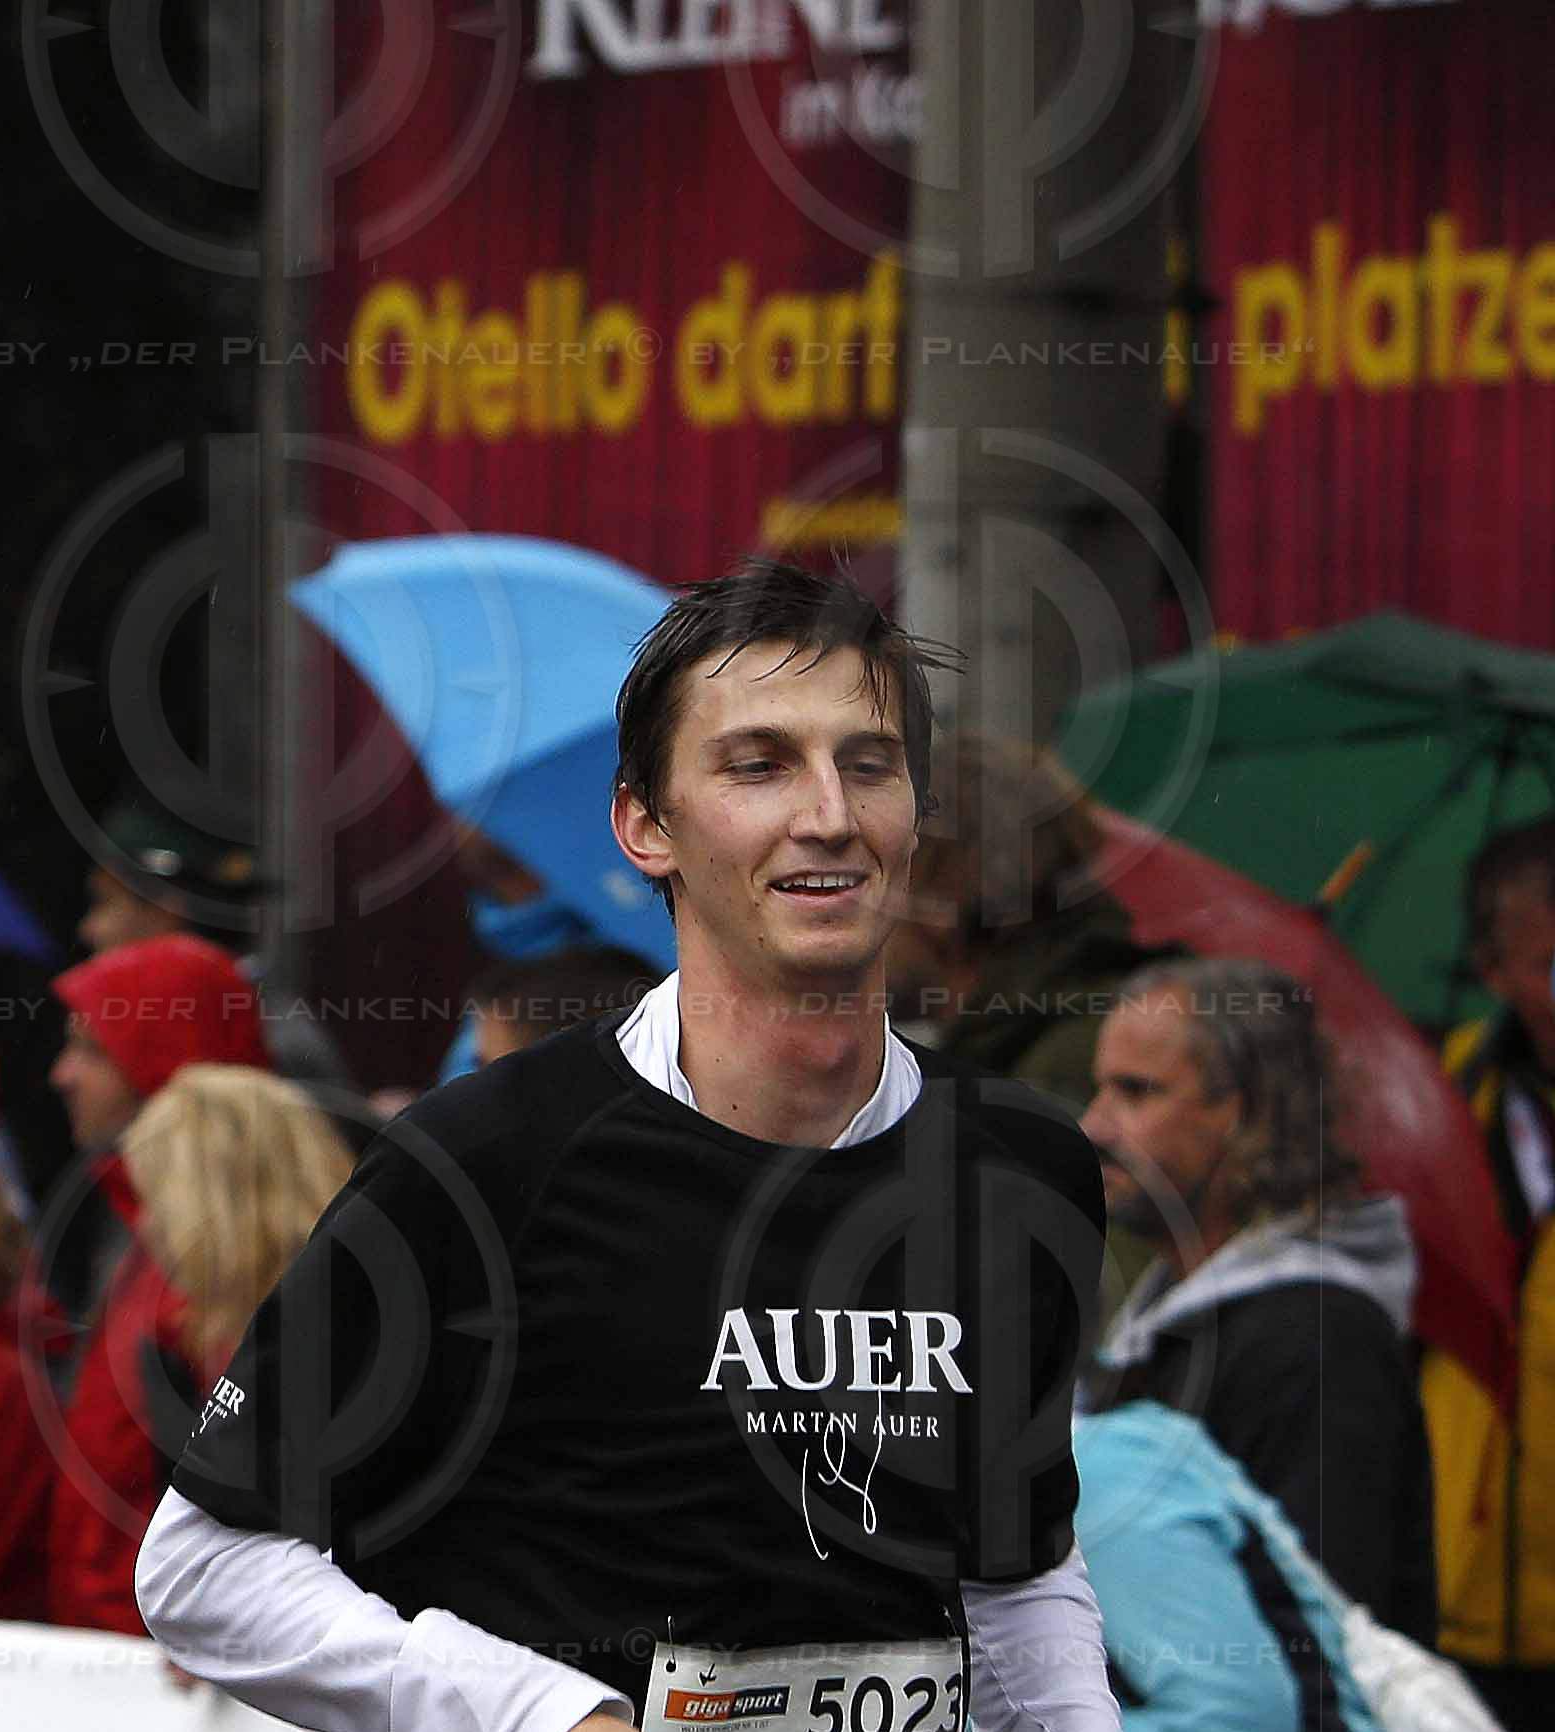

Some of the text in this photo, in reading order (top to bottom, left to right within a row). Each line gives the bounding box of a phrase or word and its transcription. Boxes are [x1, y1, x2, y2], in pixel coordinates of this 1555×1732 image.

[348, 268, 646, 444] Otello
[699, 1307, 974, 1394] AUER
[212, 1375, 246, 1416] ER
[747, 1411, 940, 1438] MARTIN AUER
[682, 1693, 784, 1718] giga sport
